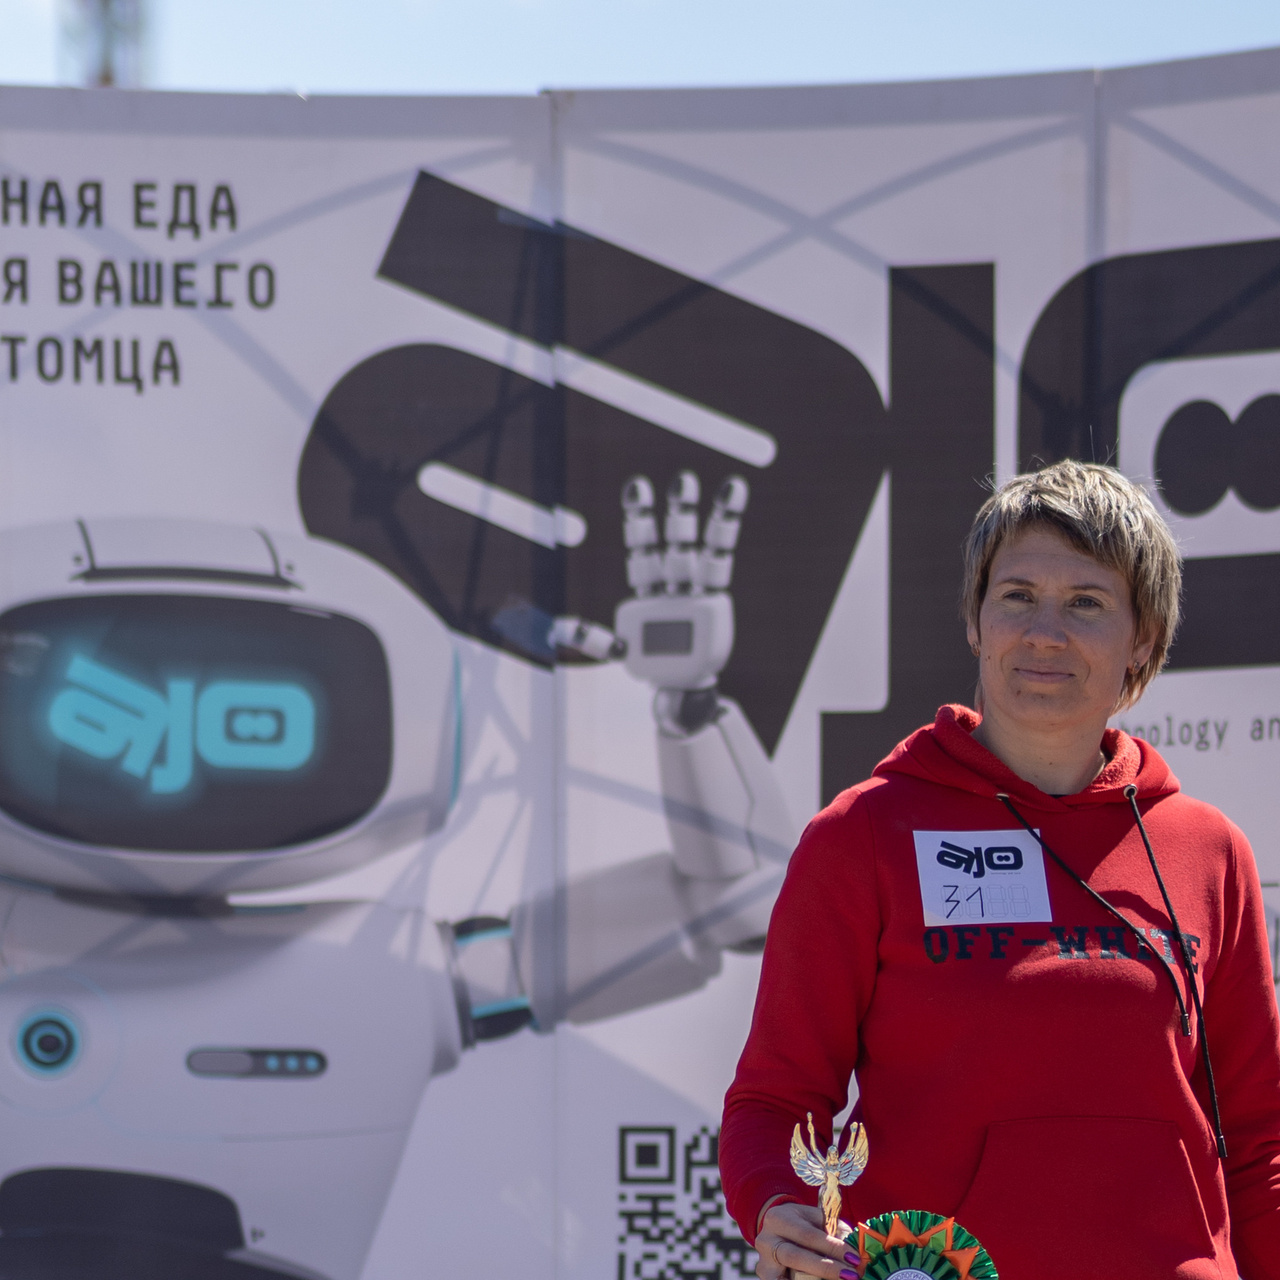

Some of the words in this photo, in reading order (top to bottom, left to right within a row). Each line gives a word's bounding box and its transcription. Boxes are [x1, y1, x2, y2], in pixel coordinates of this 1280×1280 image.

[1, 178, 102, 229] НАЯ
[133, 182, 238, 241] ЕДА
[57, 259, 276, 310] ВАШЕГО
[1, 336, 180, 395] ТОМЦА
[943, 885, 985, 919] 31
